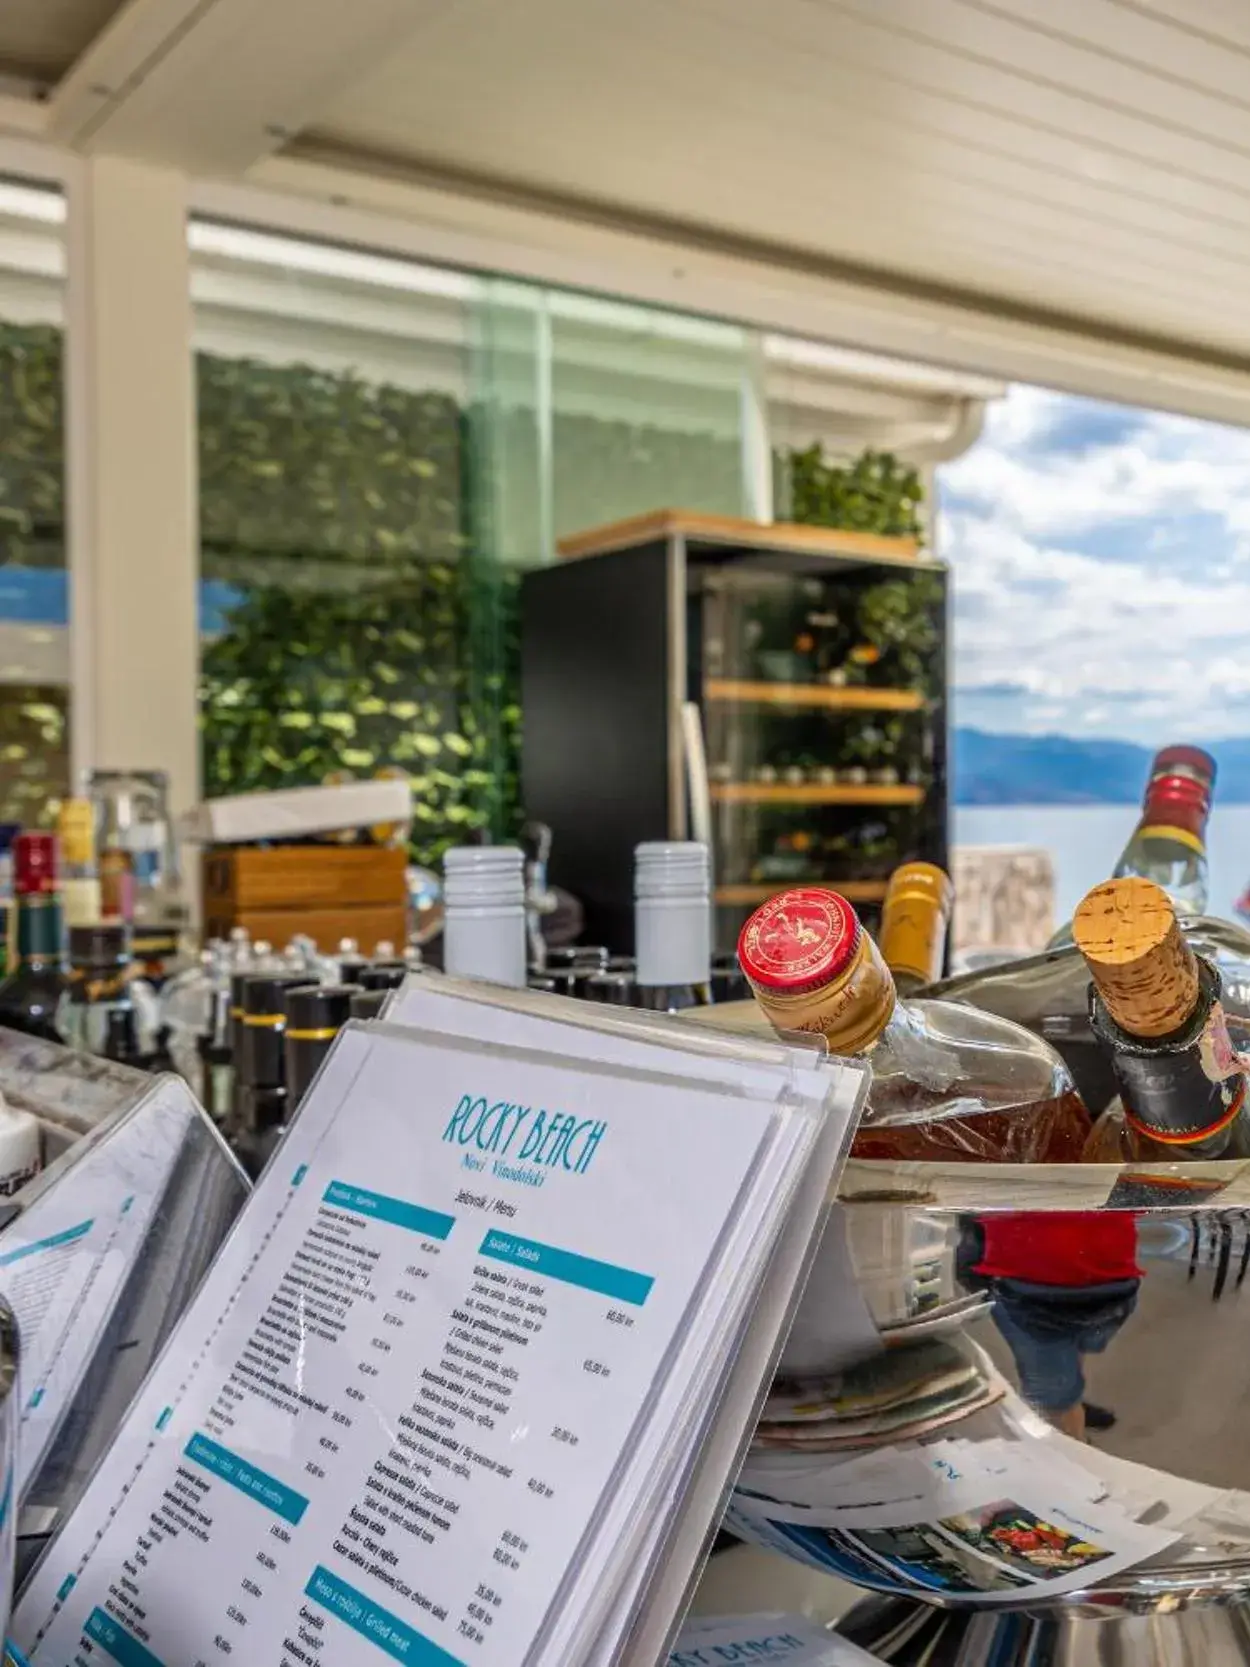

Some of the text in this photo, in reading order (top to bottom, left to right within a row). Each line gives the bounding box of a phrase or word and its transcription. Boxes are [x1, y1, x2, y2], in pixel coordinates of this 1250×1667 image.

[442, 1094, 608, 1174] ROCKY BEACH
[460, 1152, 546, 1188] Novi Vinodolski
